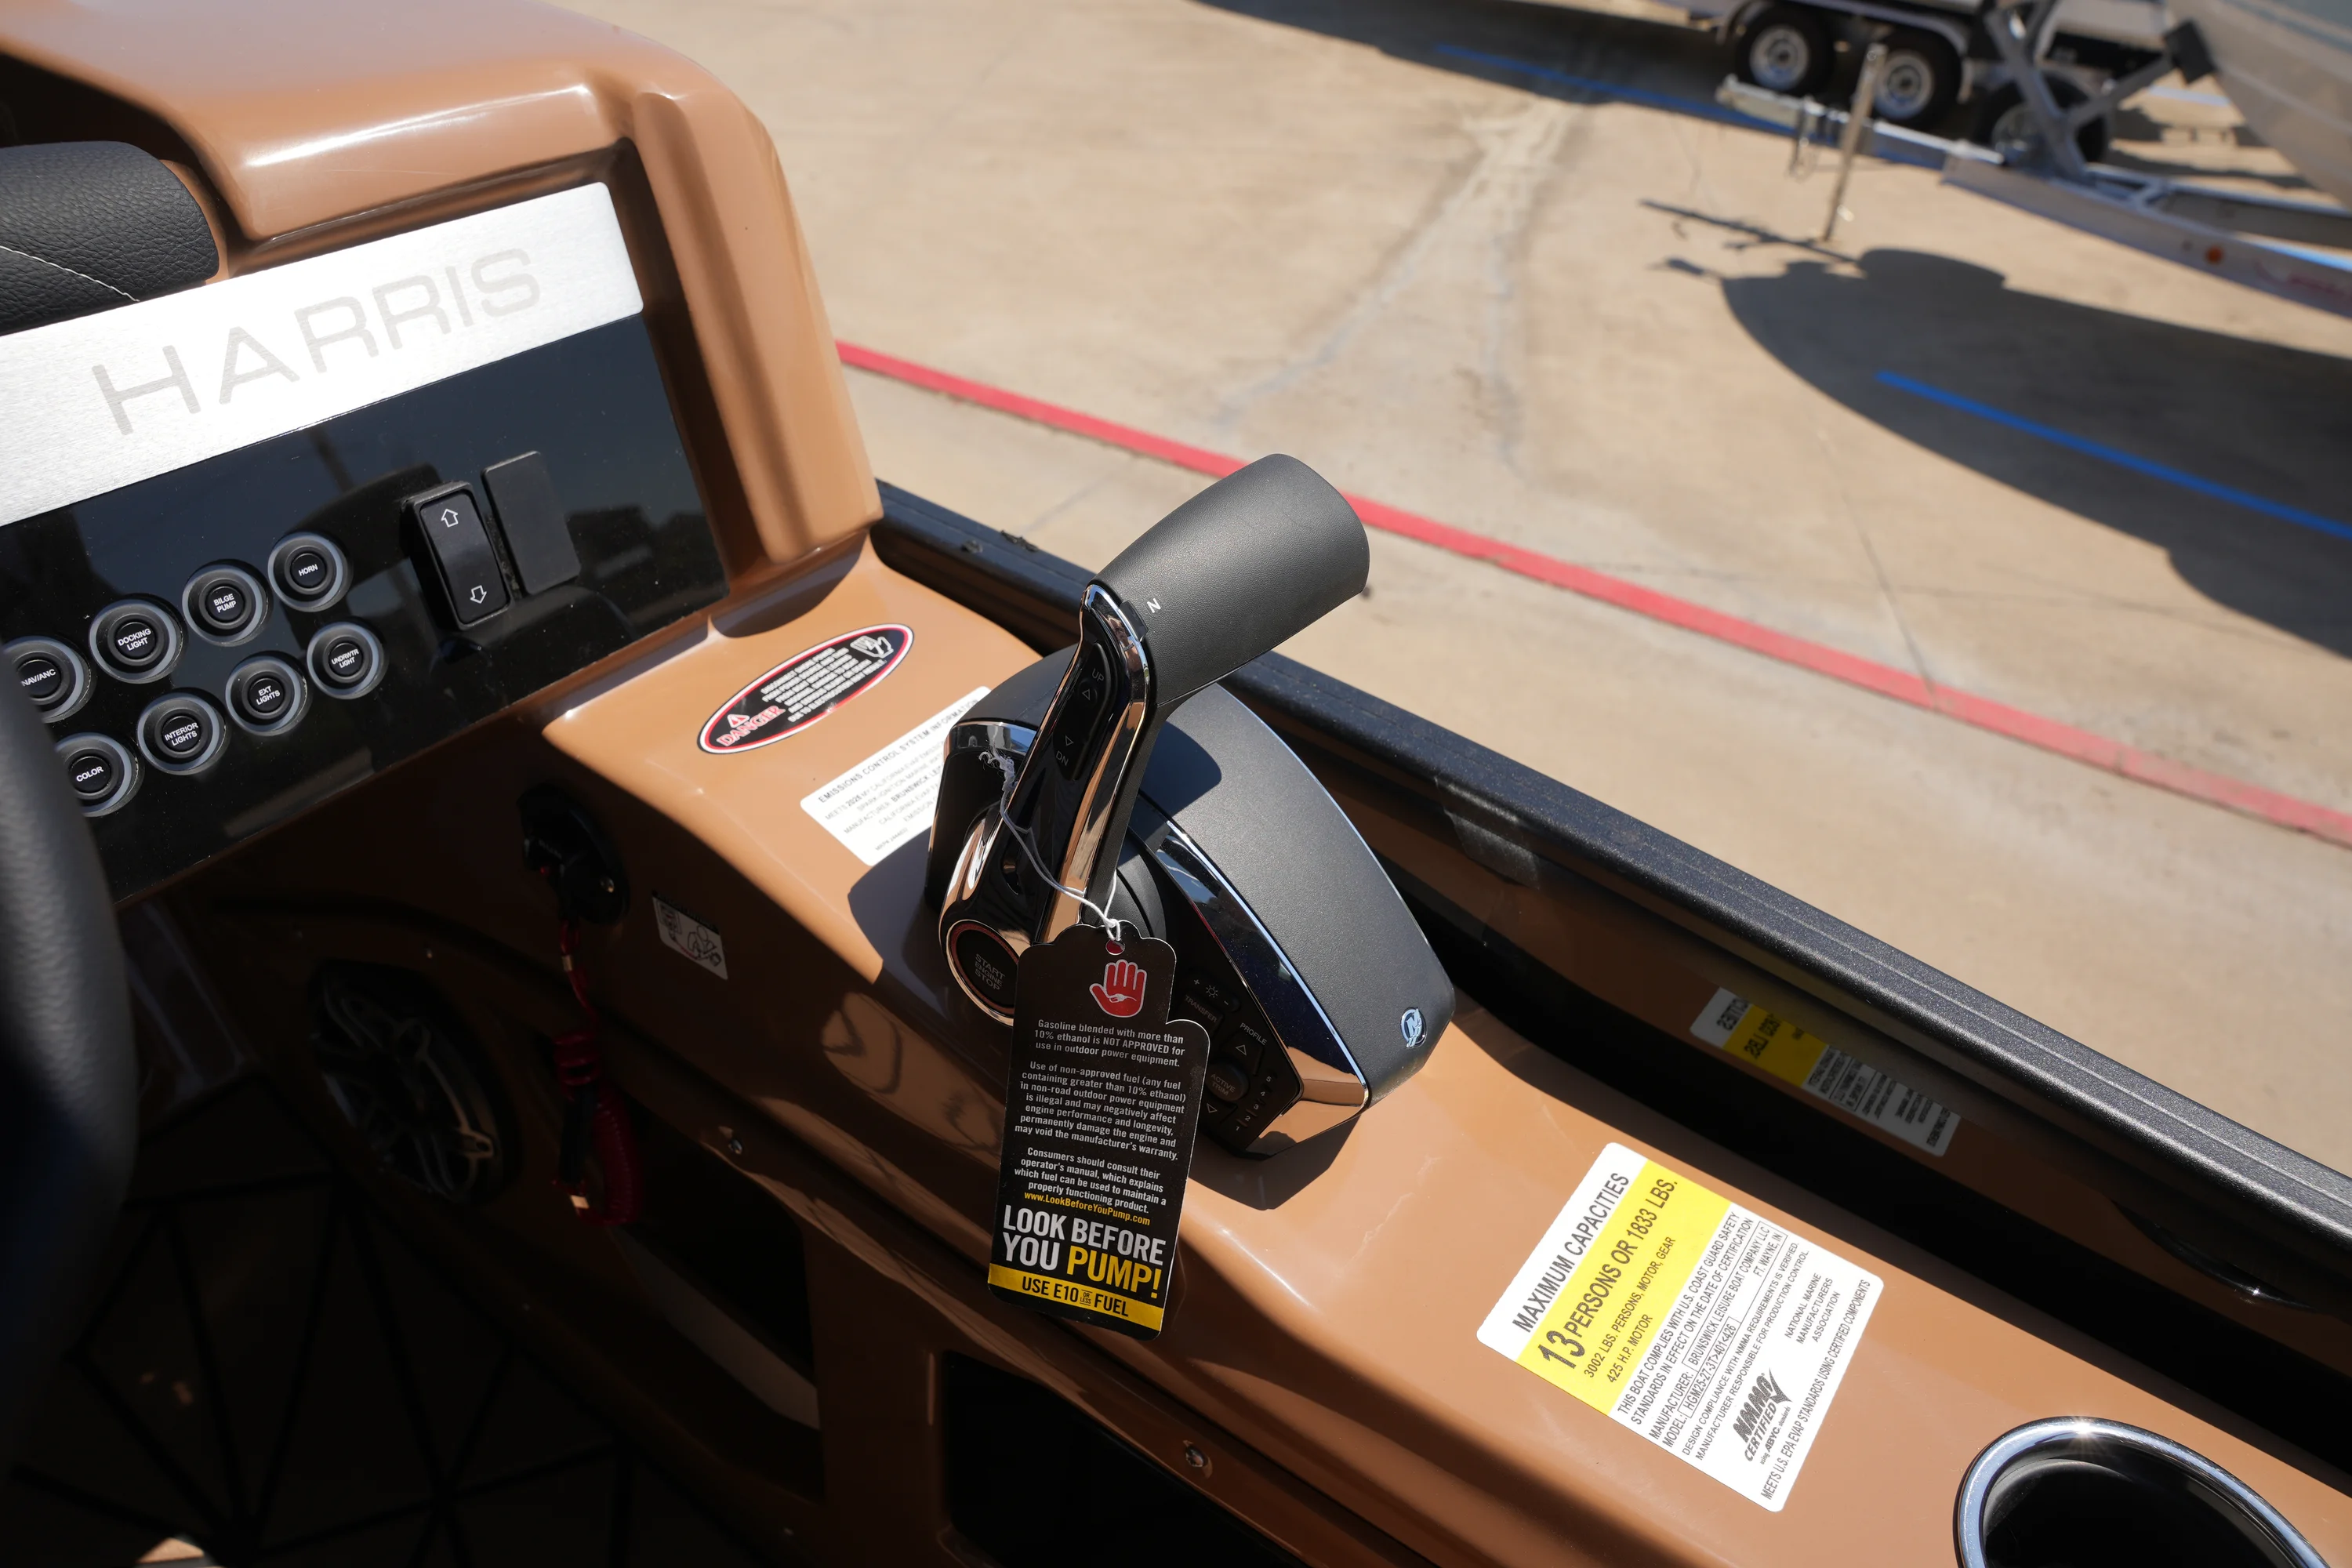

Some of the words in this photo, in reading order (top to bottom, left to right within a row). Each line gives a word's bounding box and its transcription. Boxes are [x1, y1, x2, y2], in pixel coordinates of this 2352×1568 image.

[92, 248, 541, 436] HARRIS
[298, 564, 318, 577] HORN
[213, 593, 234, 606] BILGE
[216, 601, 237, 613] PUMP
[1146, 597, 1162, 614] N
[118, 628, 152, 647] DOCKING
[126, 637, 149, 652] LIGHT
[332, 648, 359, 665] UNDRWTR
[339, 656, 355, 669] LIGHT
[1091, 667, 1105, 683] UP
[256, 689, 281, 706] LIGHTS
[259, 684, 272, 696] EXT
[165, 722, 198, 742] INTERIOR
[171, 730, 198, 746] LIGHTS
[717, 706, 786, 747] DANGER
[817, 772, 863, 803] EMISSIONS
[861, 749, 900, 775] CONTROL
[898, 728, 931, 752] SYSTEM
[1055, 750, 1069, 767] DN
[76, 765, 104, 782] COLOR
[975, 953, 1006, 980] START
[975, 961, 1004, 987] ENGINE
[975, 968, 1000, 991] STOP
[1185, 995, 1218, 1023] TRANSFER
[1035, 1029, 1054, 1040] 10%
[1057, 1033, 1091, 1044] ethanol
[1092, 1035, 1101, 1044] is
[1102, 1036, 1121, 1047] NOT
[1122, 1040, 1170, 1054] APPROVED
[1171, 1046, 1185, 1056] for
[1038, 1019, 1076, 1031] Gasoline
[1078, 1023, 1115, 1035] blended
[1116, 1028, 1135, 1038] with
[1138, 1032, 1161, 1041] more
[1163, 1033, 1184, 1044] than
[1240, 1022, 1268, 1047] PROFILE
[1065, 1045, 1100, 1055] outdoor
[1101, 1049, 1129, 1059] power
[1131, 1054, 1180, 1067] equipment.
[1029, 1061, 1046, 1071] Use
[1059, 1066, 1121, 1080] non-approved
[1123, 1073, 1141, 1083] fuel
[1142, 1076, 1162, 1088] (any
[1163, 1079, 1181, 1091] fuel
[1210, 1073, 1236, 1093] ACTIVE
[1212, 1081, 1229, 1096] TRIM
[1025, 1105, 1054, 1115] engine
[1056, 1109, 1112, 1124] performance
[1114, 1118, 1131, 1127] and
[1133, 1120, 1174, 1137] longevity,
[1014, 1125, 1033, 1135] may
[1035, 1127, 1053, 1137] void
[1054, 1129, 1069, 1139] the
[1071, 1133, 1137, 1152] manufacturer's
[1138, 1145, 1178, 1161] warranty.
[1020, 1159, 1065, 1172] operator's
[1066, 1166, 1100, 1180] manual,
[1102, 1172, 1127, 1185] which
[1128, 1178, 1163, 1193] explains
[1027, 1147, 1075, 1163] Consumers
[1076, 1156, 1105, 1168] should
[1106, 1162, 1138, 1175] consult
[1140, 1167, 1161, 1180] their
[1024, 1192, 1151, 1226] www.LookBeforeYouPump.com
[1028, 1181, 1065, 1196] properly
[1065, 1186, 1113, 1206] functioning
[1114, 1199, 1149, 1214] product.
[1004, 1204, 1067, 1240] LOOK
[1070, 1218, 1167, 1266] BEFORE
[1771, 1232, 1783, 1242] IN
[1003, 1232, 1061, 1271] YOU
[1066, 1245, 1162, 1299] PUMP!
[1512, 1254, 1576, 1333] MAXIMUM
[1564, 1173, 1629, 1256] CAPACITIES
[1758, 1241, 1780, 1267] WAYNE,
[1777, 1240, 1799, 1272] VERIFIED.
[1537, 1330, 1585, 1370] 13
[1563, 1263, 1622, 1338] PERSONS
[1610, 1240, 1639, 1265] OR
[1626, 1208, 1657, 1240] 1833
[1645, 1178, 1678, 1209] LBS.
[1752, 1265, 1766, 1277] FT.
[1774, 1272, 1784, 1280] IS
[1022, 1276, 1051, 1296] USE
[1053, 1283, 1080, 1303] E10
[1094, 1293, 1129, 1317] FUEL
[1584, 1352, 1606, 1378] 3002
[1599, 1334, 1618, 1353] LBS.
[1610, 1292, 1645, 1333] PERSONS,
[1636, 1261, 1664, 1292] MOTOR,
[1655, 1236, 1676, 1260] GEAR
[1746, 1279, 1779, 1334] REQUIREMENTS
[1784, 1303, 1808, 1339] NATIONAL
[1802, 1272, 1822, 1302] MARINE
[1842, 1279, 1871, 1325] COMPONENTS
[1617, 1393, 1637, 1414] THIS
[1629, 1369, 1650, 1396] BOAT
[1643, 1328, 1674, 1371] COMPLIES
[1666, 1307, 1686, 1330] WITH
[1679, 1294, 1695, 1309] U.S.
[1688, 1265, 1709, 1294] COAST
[1703, 1240, 1725, 1267] GUARD
[1718, 1211, 1740, 1241] SAFETY
[1795, 1277, 1833, 1345] MANUFACTURERS
[1811, 1291, 1841, 1343] ASSOCIATION
[1648, 1371, 1694, 1440] MANUFACTURER:
[1687, 1319, 1719, 1366] BRUNSWICK
[1711, 1290, 1736, 1323] LEISURE
[1728, 1271, 1745, 1293] BOAT
[1738, 1239, 1762, 1273] COMPANY
[1755, 1226, 1770, 1242] LLC
[1734, 1334, 1752, 1356] NMMA
[1827, 1323, 1851, 1359] CERTIFIED
[1606, 1362, 1624, 1383] 425
[1617, 1346, 1635, 1364] H.P.
[1627, 1313, 1653, 1347] MOTOR
[1724, 1355, 1740, 1375] WITH
[1817, 1356, 1835, 1380] USING
[1661, 1414, 1688, 1448] MODEL:
[1682, 1323, 1737, 1411] HGM25-27-3T>401<426
[1698, 1374, 1730, 1425] COMPLIANCE
[1797, 1378, 1825, 1423] STANDARDS
[1682, 1424, 1704, 1456] DESIGN
[1744, 1400, 1777, 1462] CERTIFIED
[1759, 1450, 1770, 1465] using
[1777, 1404, 1791, 1427] standards
[1788, 1420, 1805, 1443] EVAP
[1780, 1440, 1797, 1458] EPA
[1773, 1457, 1790, 1473] U.S.
[1760, 1471, 1782, 1501] MEETS
